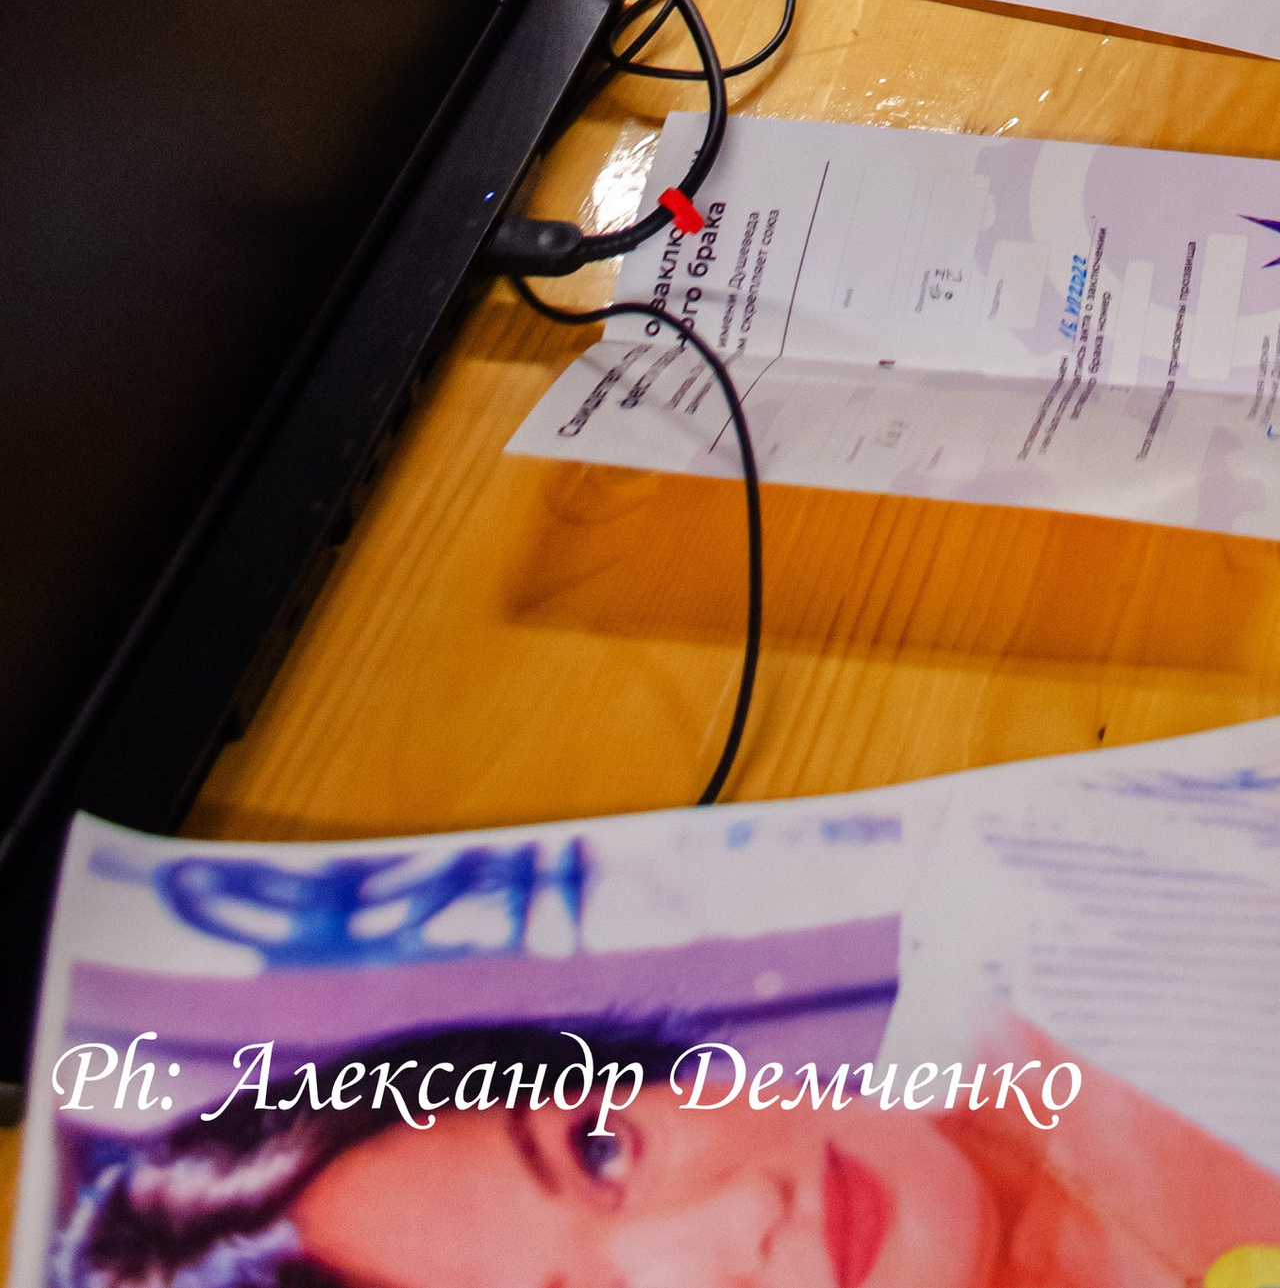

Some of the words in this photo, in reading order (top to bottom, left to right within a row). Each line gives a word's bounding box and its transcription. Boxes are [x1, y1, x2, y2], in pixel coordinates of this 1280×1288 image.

[687, 201, 727, 278] брака
[717, 294, 737, 349] имени
[728, 210, 761, 291] Душеведа
[742, 249, 766, 334] скрепляет
[761, 209, 780, 247] союз
